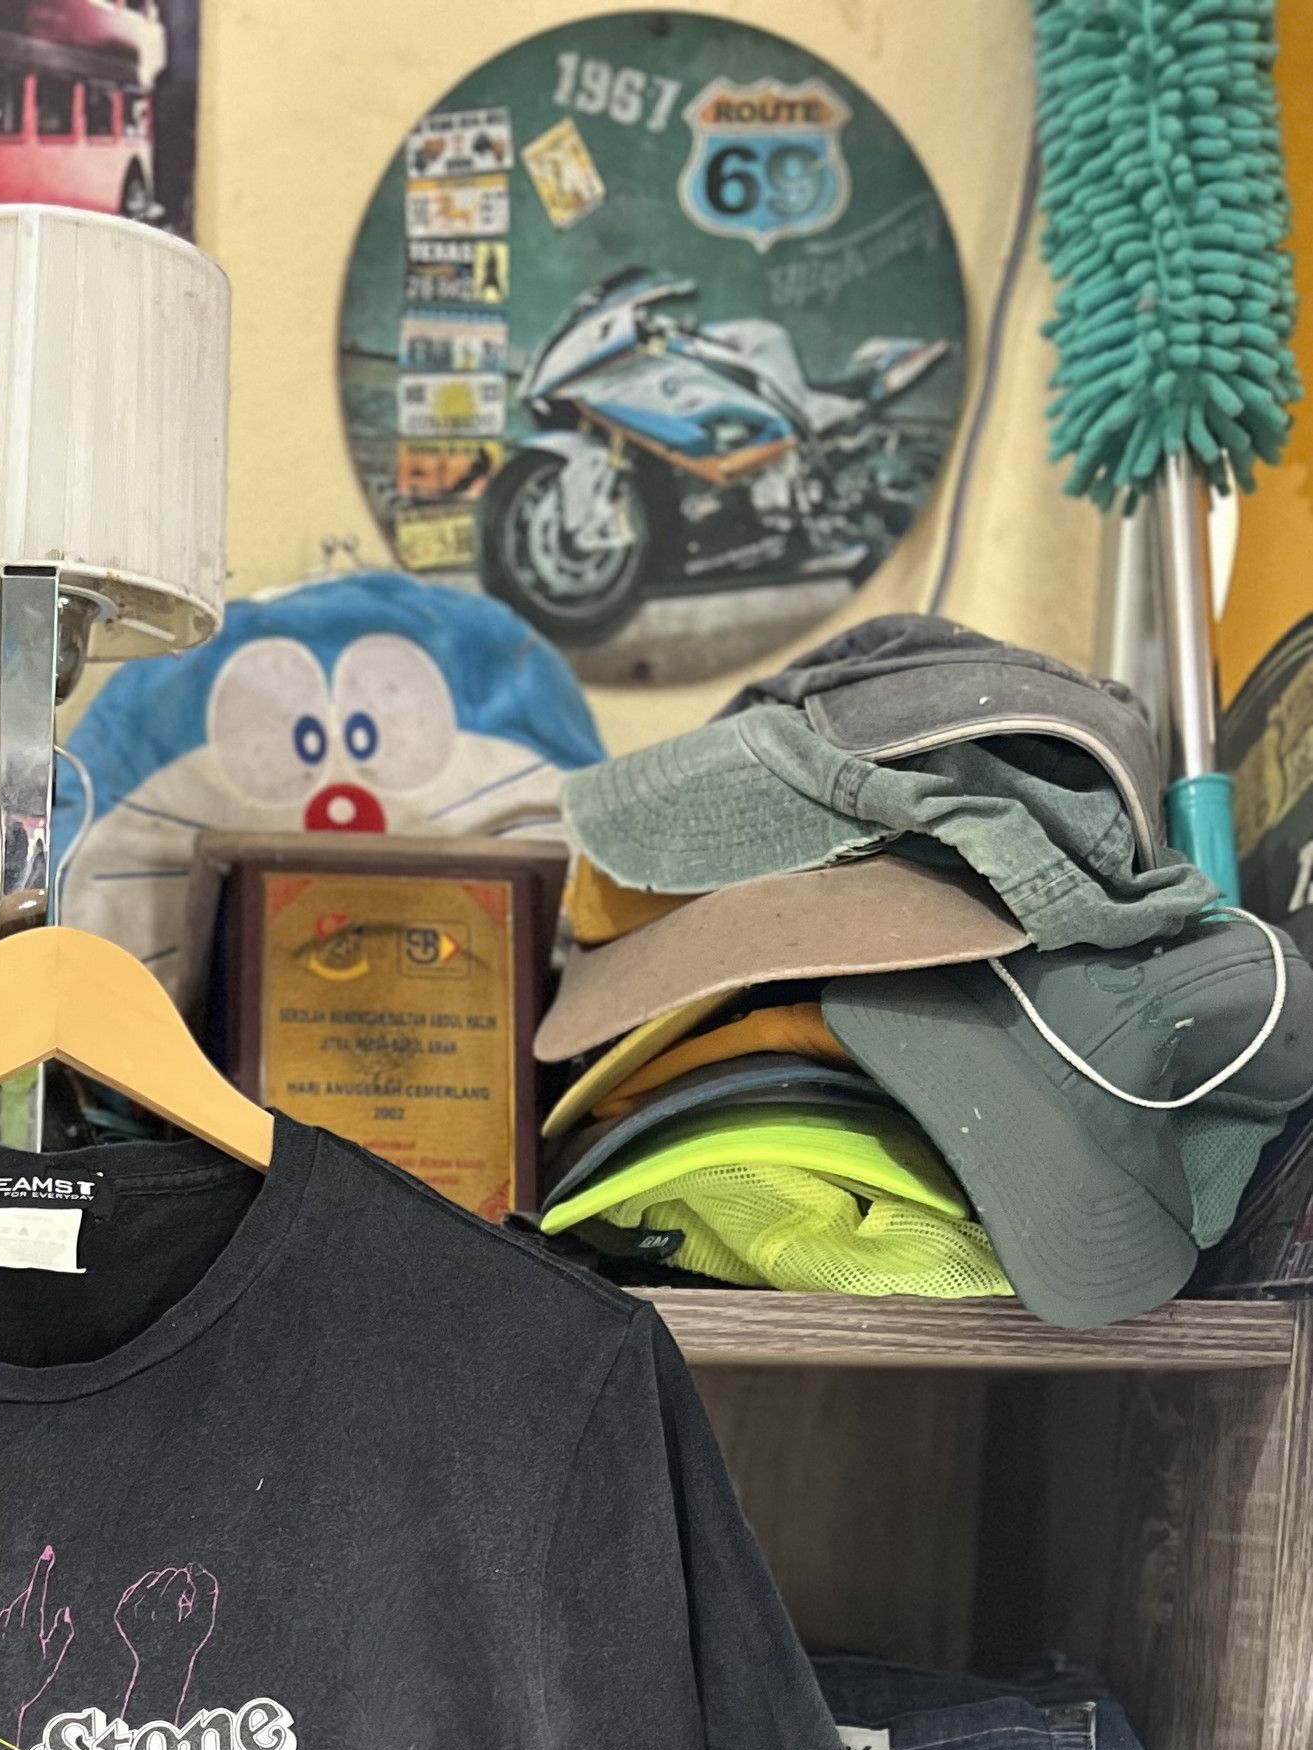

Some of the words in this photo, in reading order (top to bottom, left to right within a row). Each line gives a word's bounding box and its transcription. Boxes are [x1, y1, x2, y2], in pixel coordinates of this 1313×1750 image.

[553, 53, 682, 133] 1967
[714, 101, 820, 124] ROUTE
[32, 1191, 95, 1201] EVERYDAY
